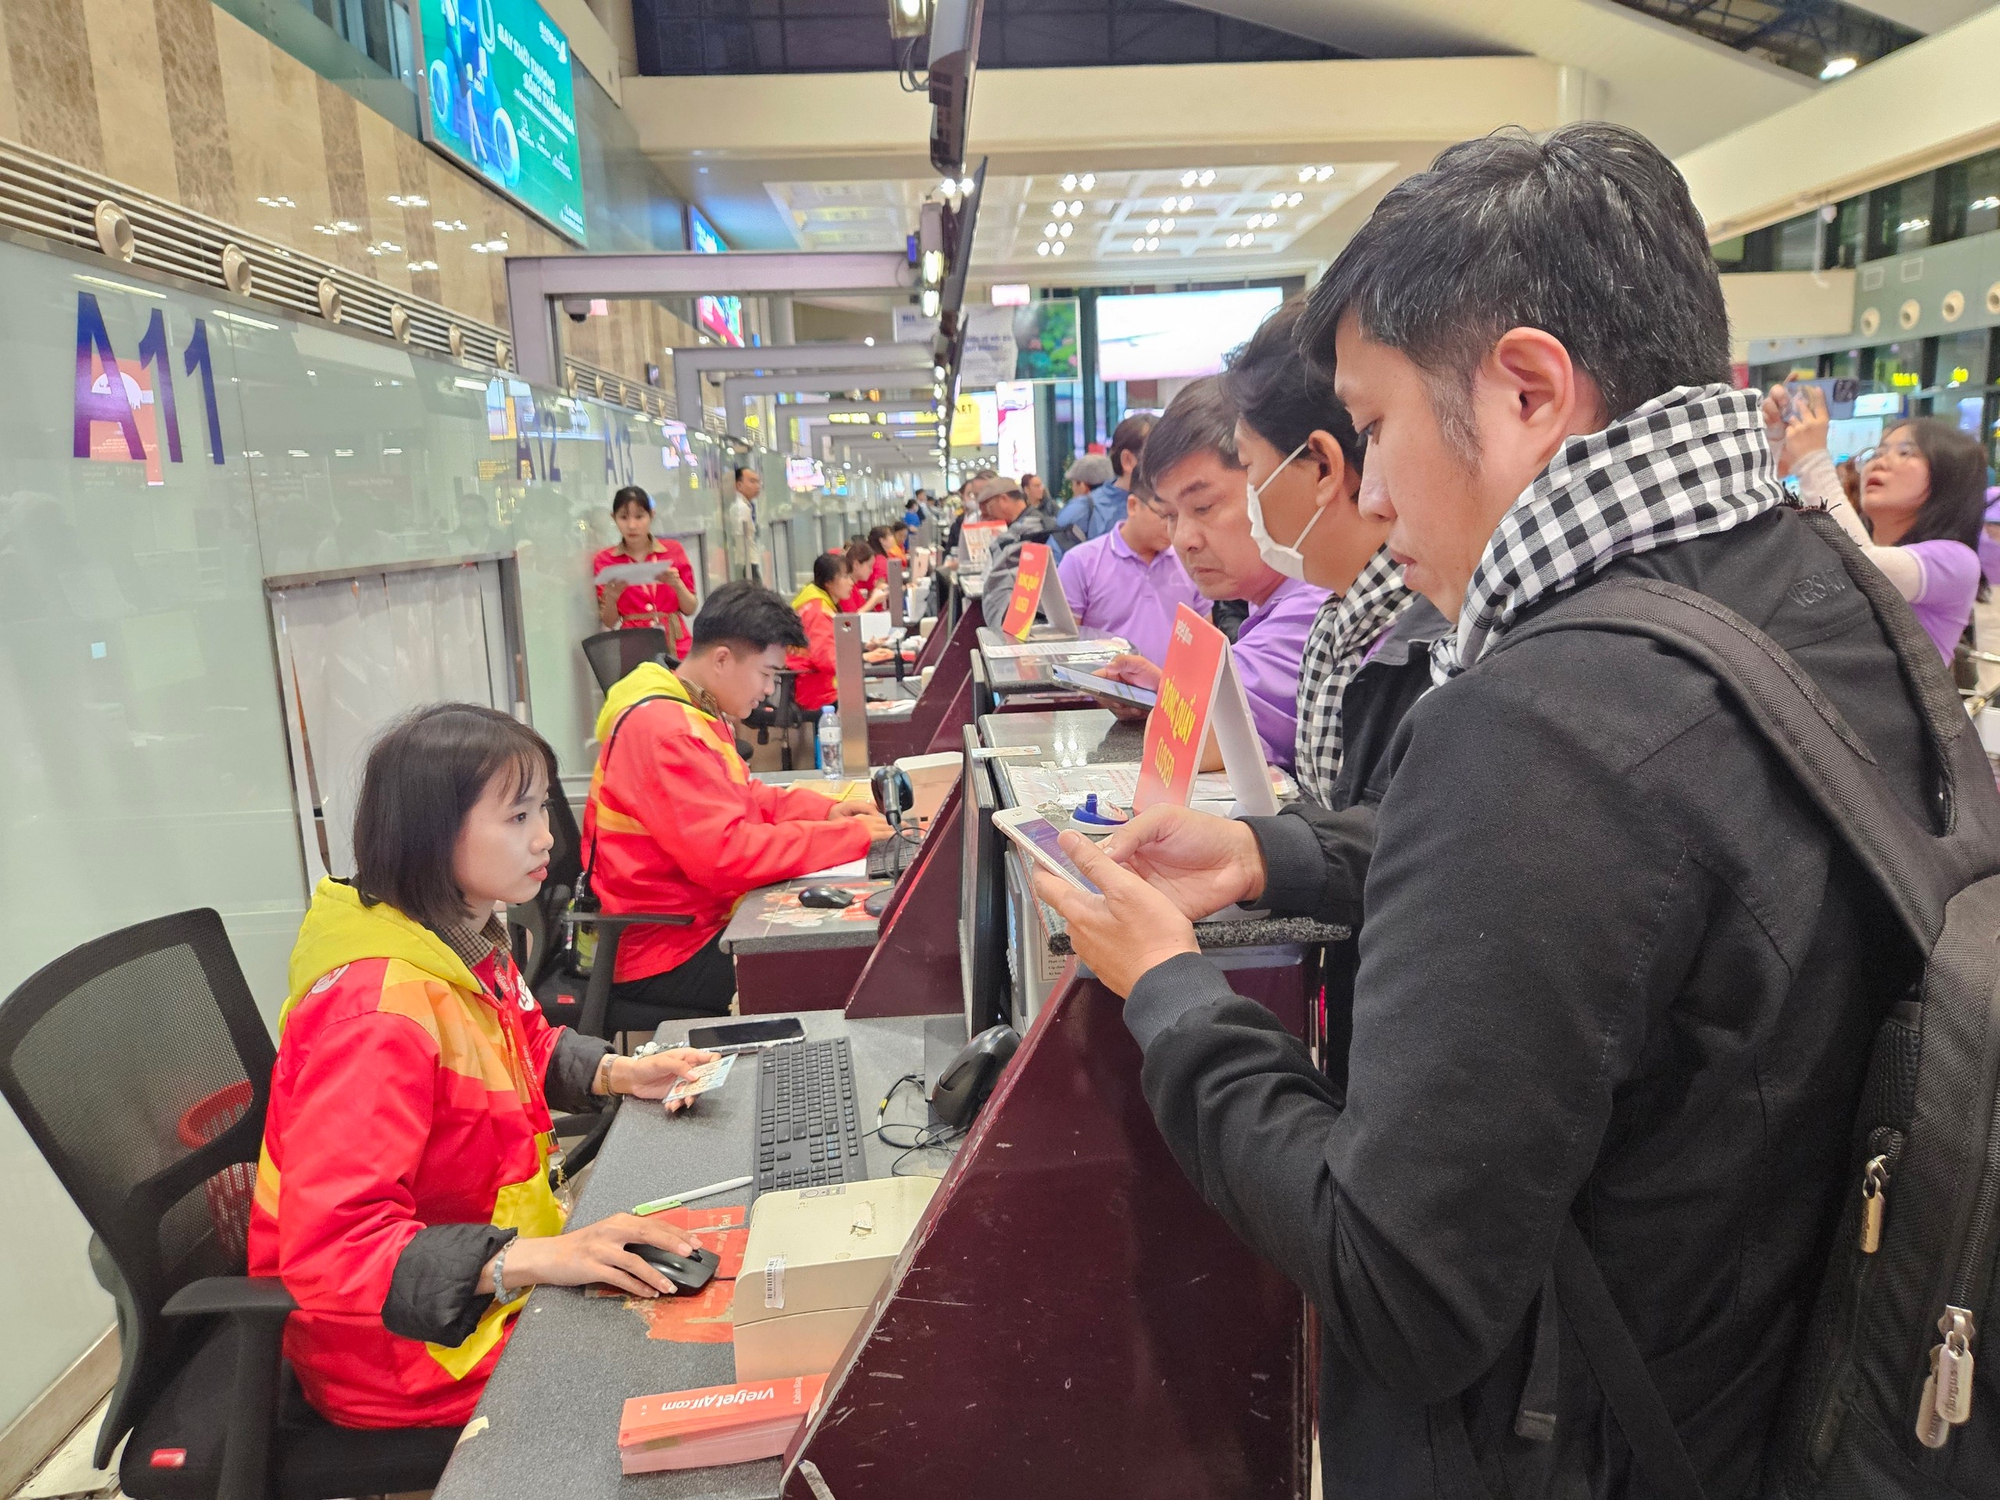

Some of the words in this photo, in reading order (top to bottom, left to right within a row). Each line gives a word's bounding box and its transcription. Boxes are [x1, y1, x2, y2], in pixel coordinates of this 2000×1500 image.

[73, 290, 225, 465] A11
[515, 396, 562, 482] A12
[604, 407, 634, 487] A13
[1155, 736, 1175, 789] CLOSED
